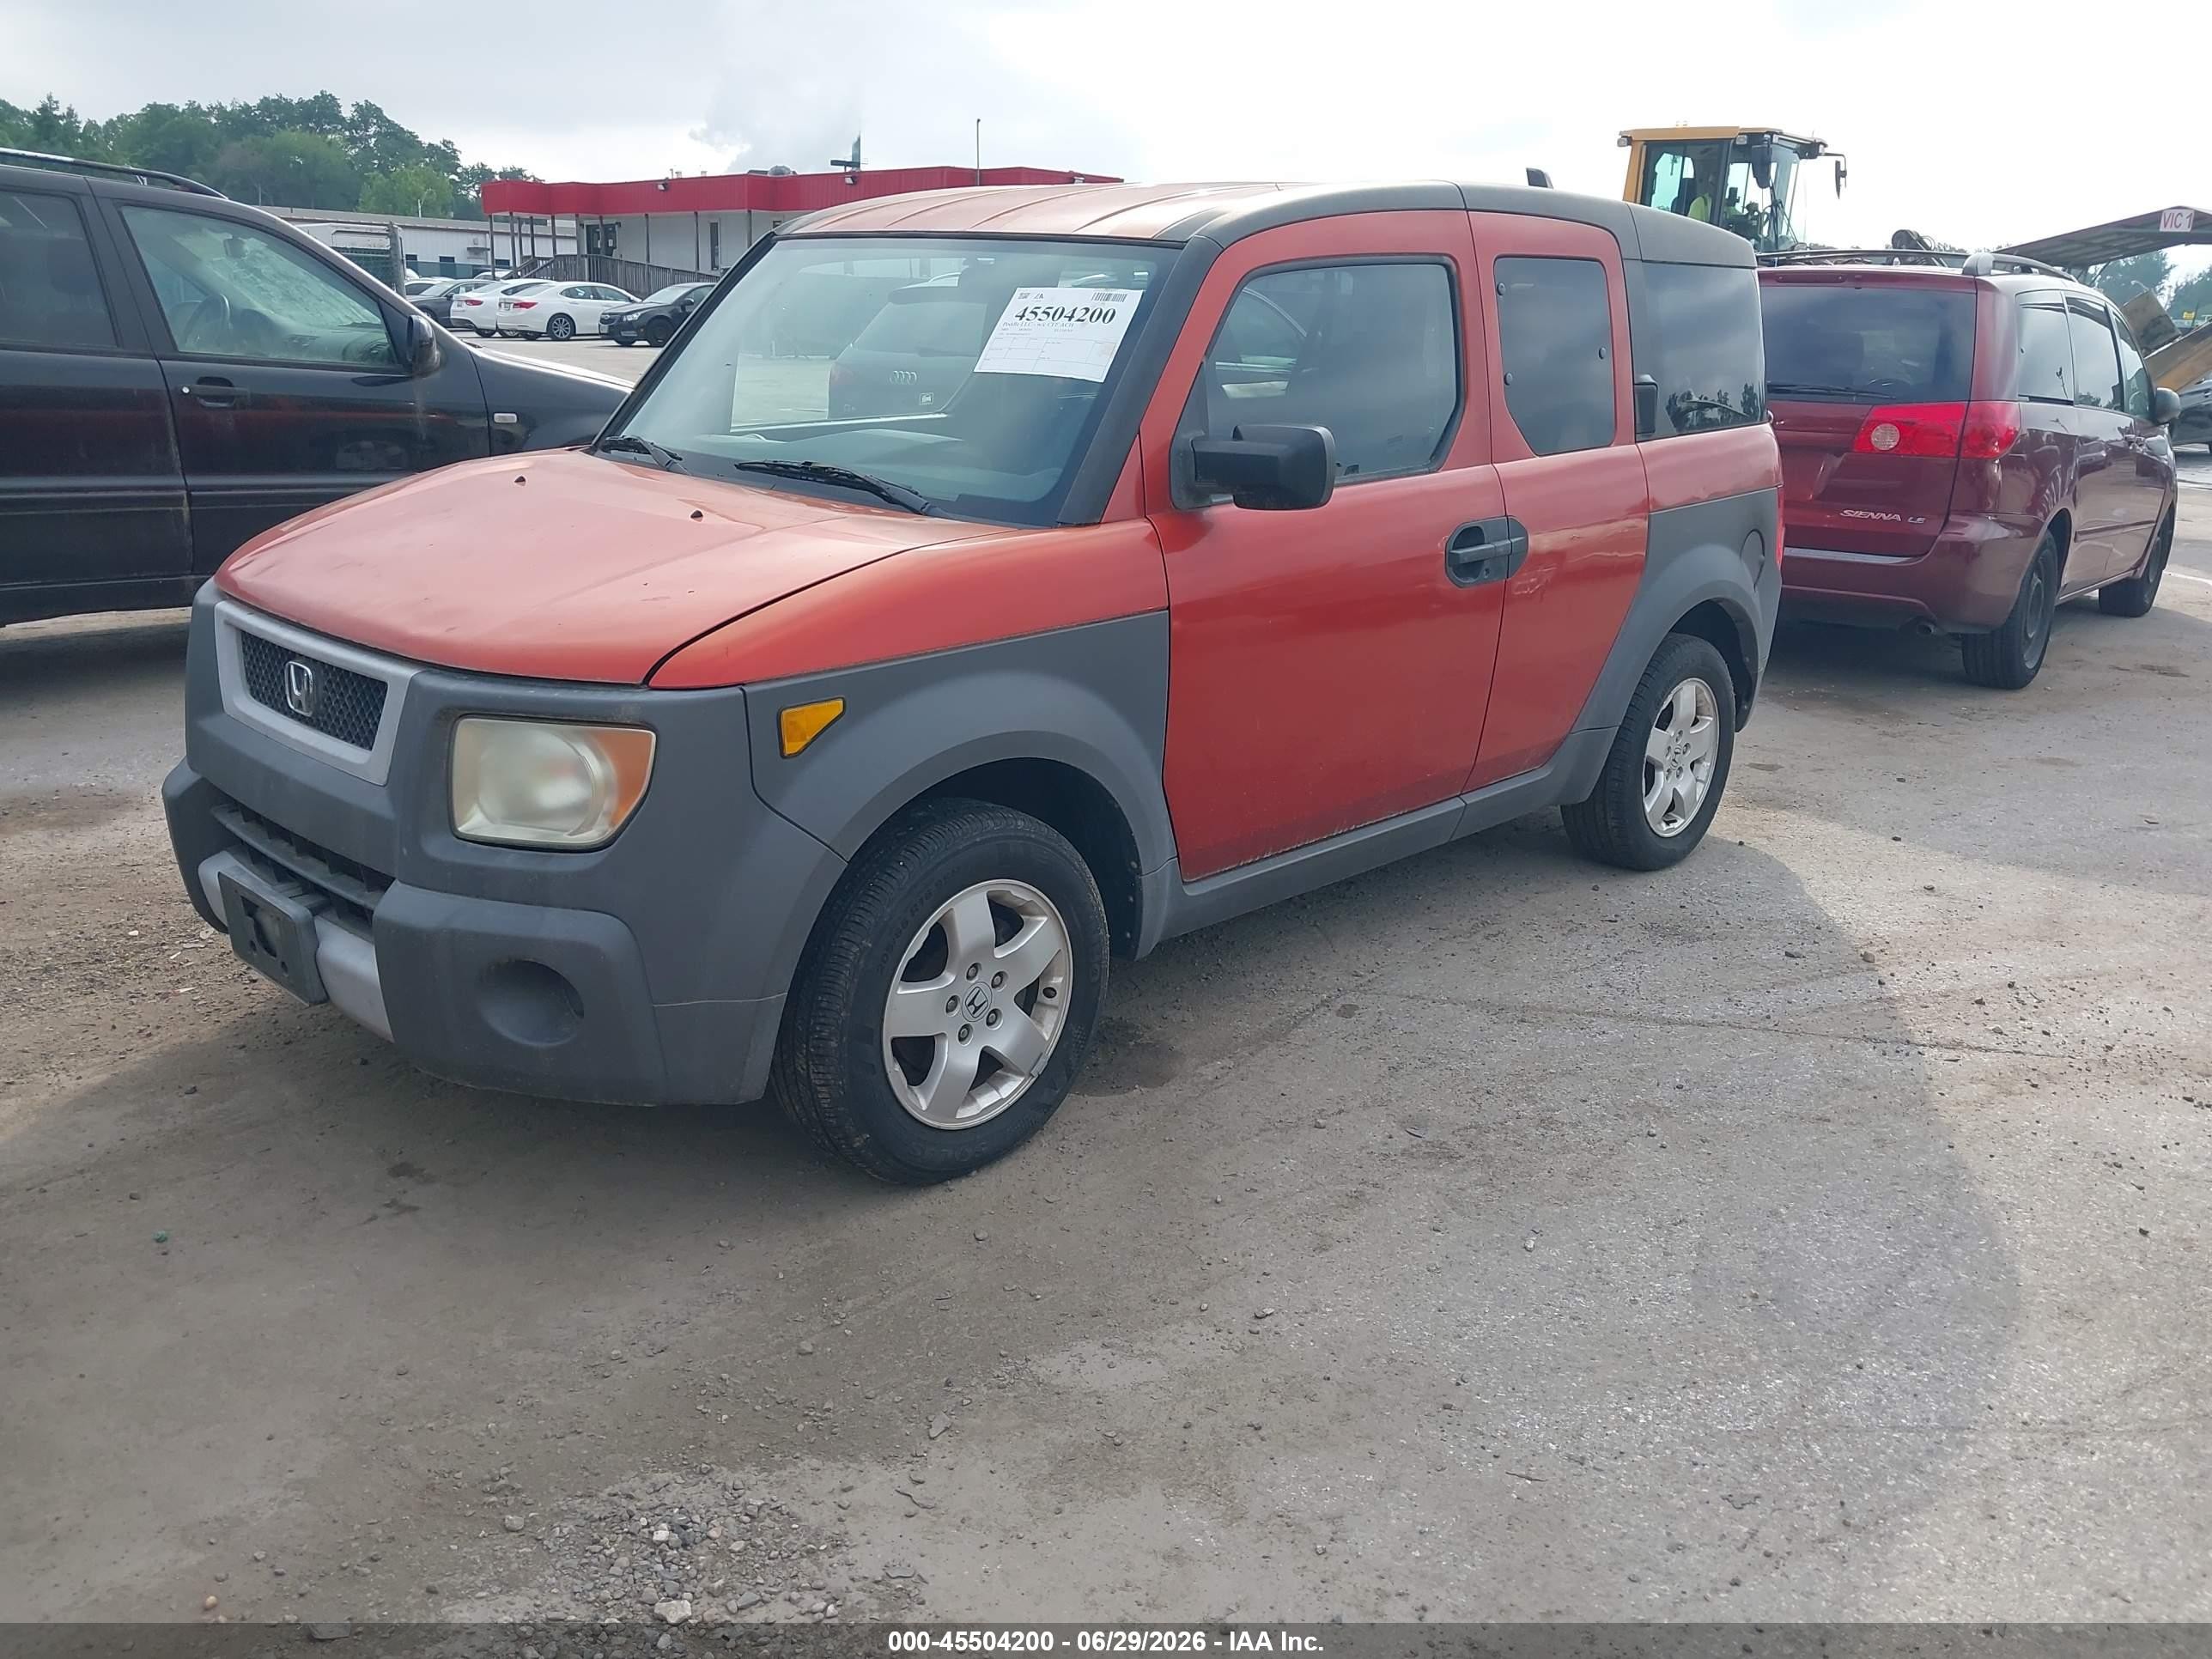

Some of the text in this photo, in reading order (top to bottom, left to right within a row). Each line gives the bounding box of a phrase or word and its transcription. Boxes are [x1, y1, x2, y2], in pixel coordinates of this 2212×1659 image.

[2163, 212, 2193, 228] VIC 1
[1014, 306, 1116, 325] 45504200
[1839, 509, 1902, 522] SIENNA
